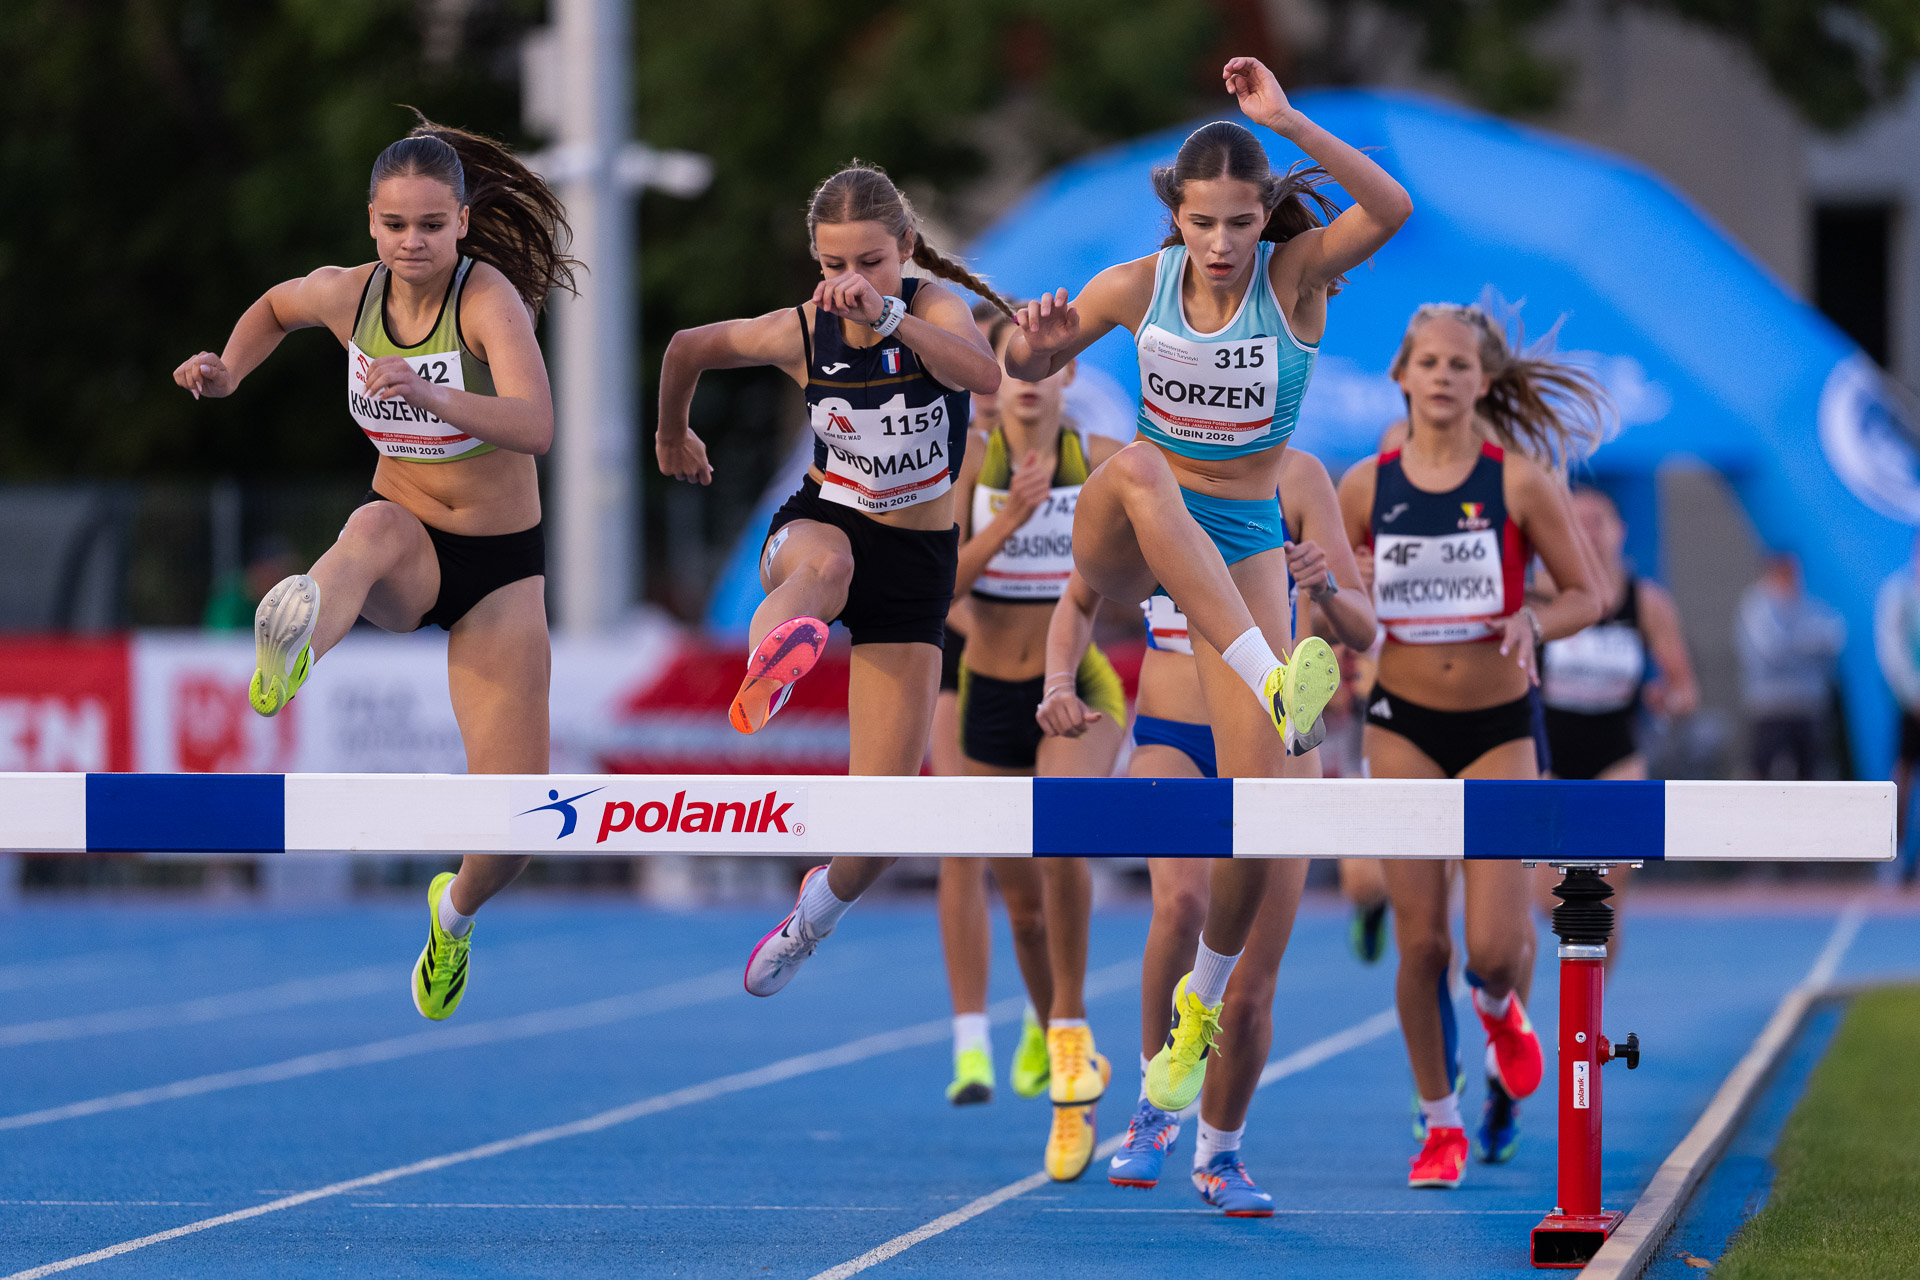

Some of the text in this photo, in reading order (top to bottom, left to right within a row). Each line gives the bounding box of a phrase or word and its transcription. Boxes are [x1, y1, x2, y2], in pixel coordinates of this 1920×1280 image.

[1214, 345, 1264, 369] 315
[417, 361, 450, 384] 42
[1147, 372, 1265, 409] GORZEŃ
[350, 389, 445, 424] KRUSZEW
[880, 405, 943, 436] 1159
[1170, 426, 1235, 442] LUBIN 2026
[386, 445, 446, 456] LUBIN 2026
[829, 439, 944, 478] GROMALA
[857, 493, 918, 509] LUBIN 2026
[1382, 538, 1487, 567] 4F 366
[1378, 573, 1497, 607] WIĘCKOWSKA
[595, 789, 796, 845] polanik
[1578, 1077, 1586, 1107] polanik
